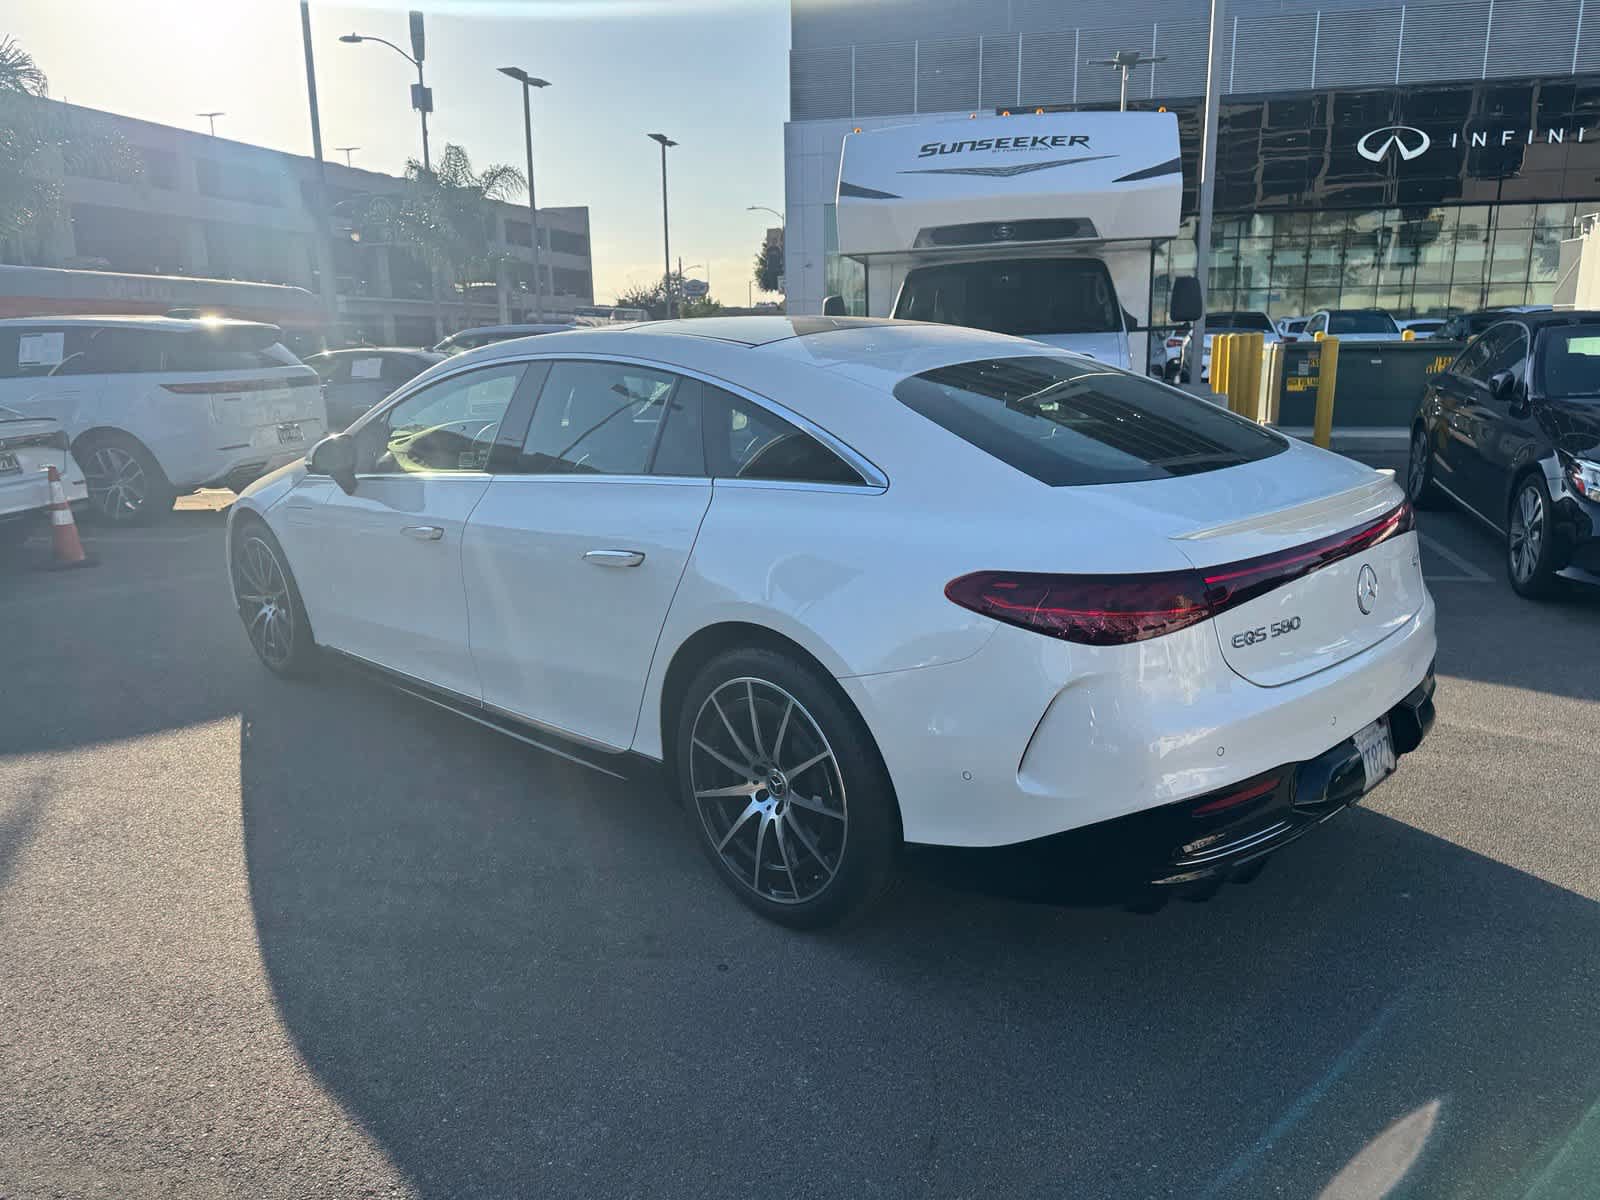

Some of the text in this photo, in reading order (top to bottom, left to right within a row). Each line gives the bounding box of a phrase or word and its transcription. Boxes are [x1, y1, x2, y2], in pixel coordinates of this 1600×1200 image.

[918, 135, 1091, 158] SUNSEEKER
[1452, 127, 1585, 148] INFINI
[1231, 615, 1301, 649] EQS 580
